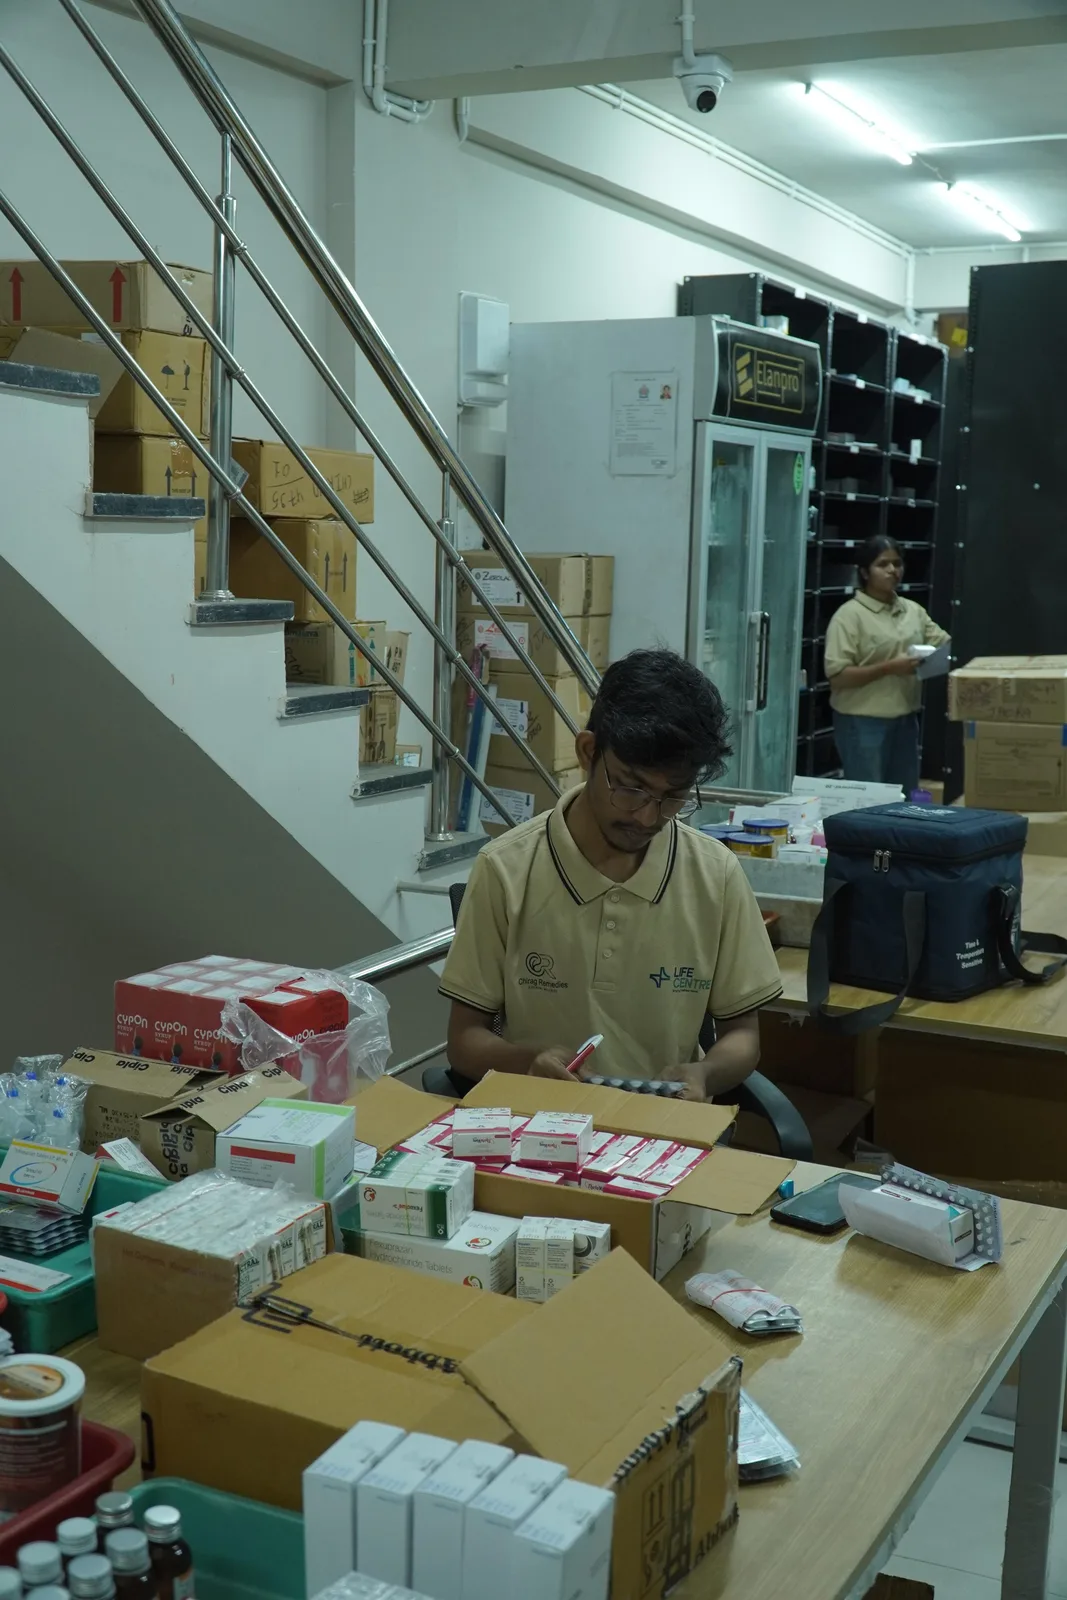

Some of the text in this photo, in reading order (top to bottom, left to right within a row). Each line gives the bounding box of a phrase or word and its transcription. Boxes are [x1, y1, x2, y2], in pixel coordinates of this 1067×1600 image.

[757, 361, 799, 403] Elanpro
[673, 967, 694, 978] LIFE
[518, 977, 568, 989] Chirag Remedies
[673, 978, 711, 989] CENTRE
[116, 1060, 149, 1072] Cipla
[218, 1080, 248, 1095] Cipla
[369, 1239, 413, 1254] Fexuprazan
[370, 1251, 453, 1273] Hydrochloride Tablets
